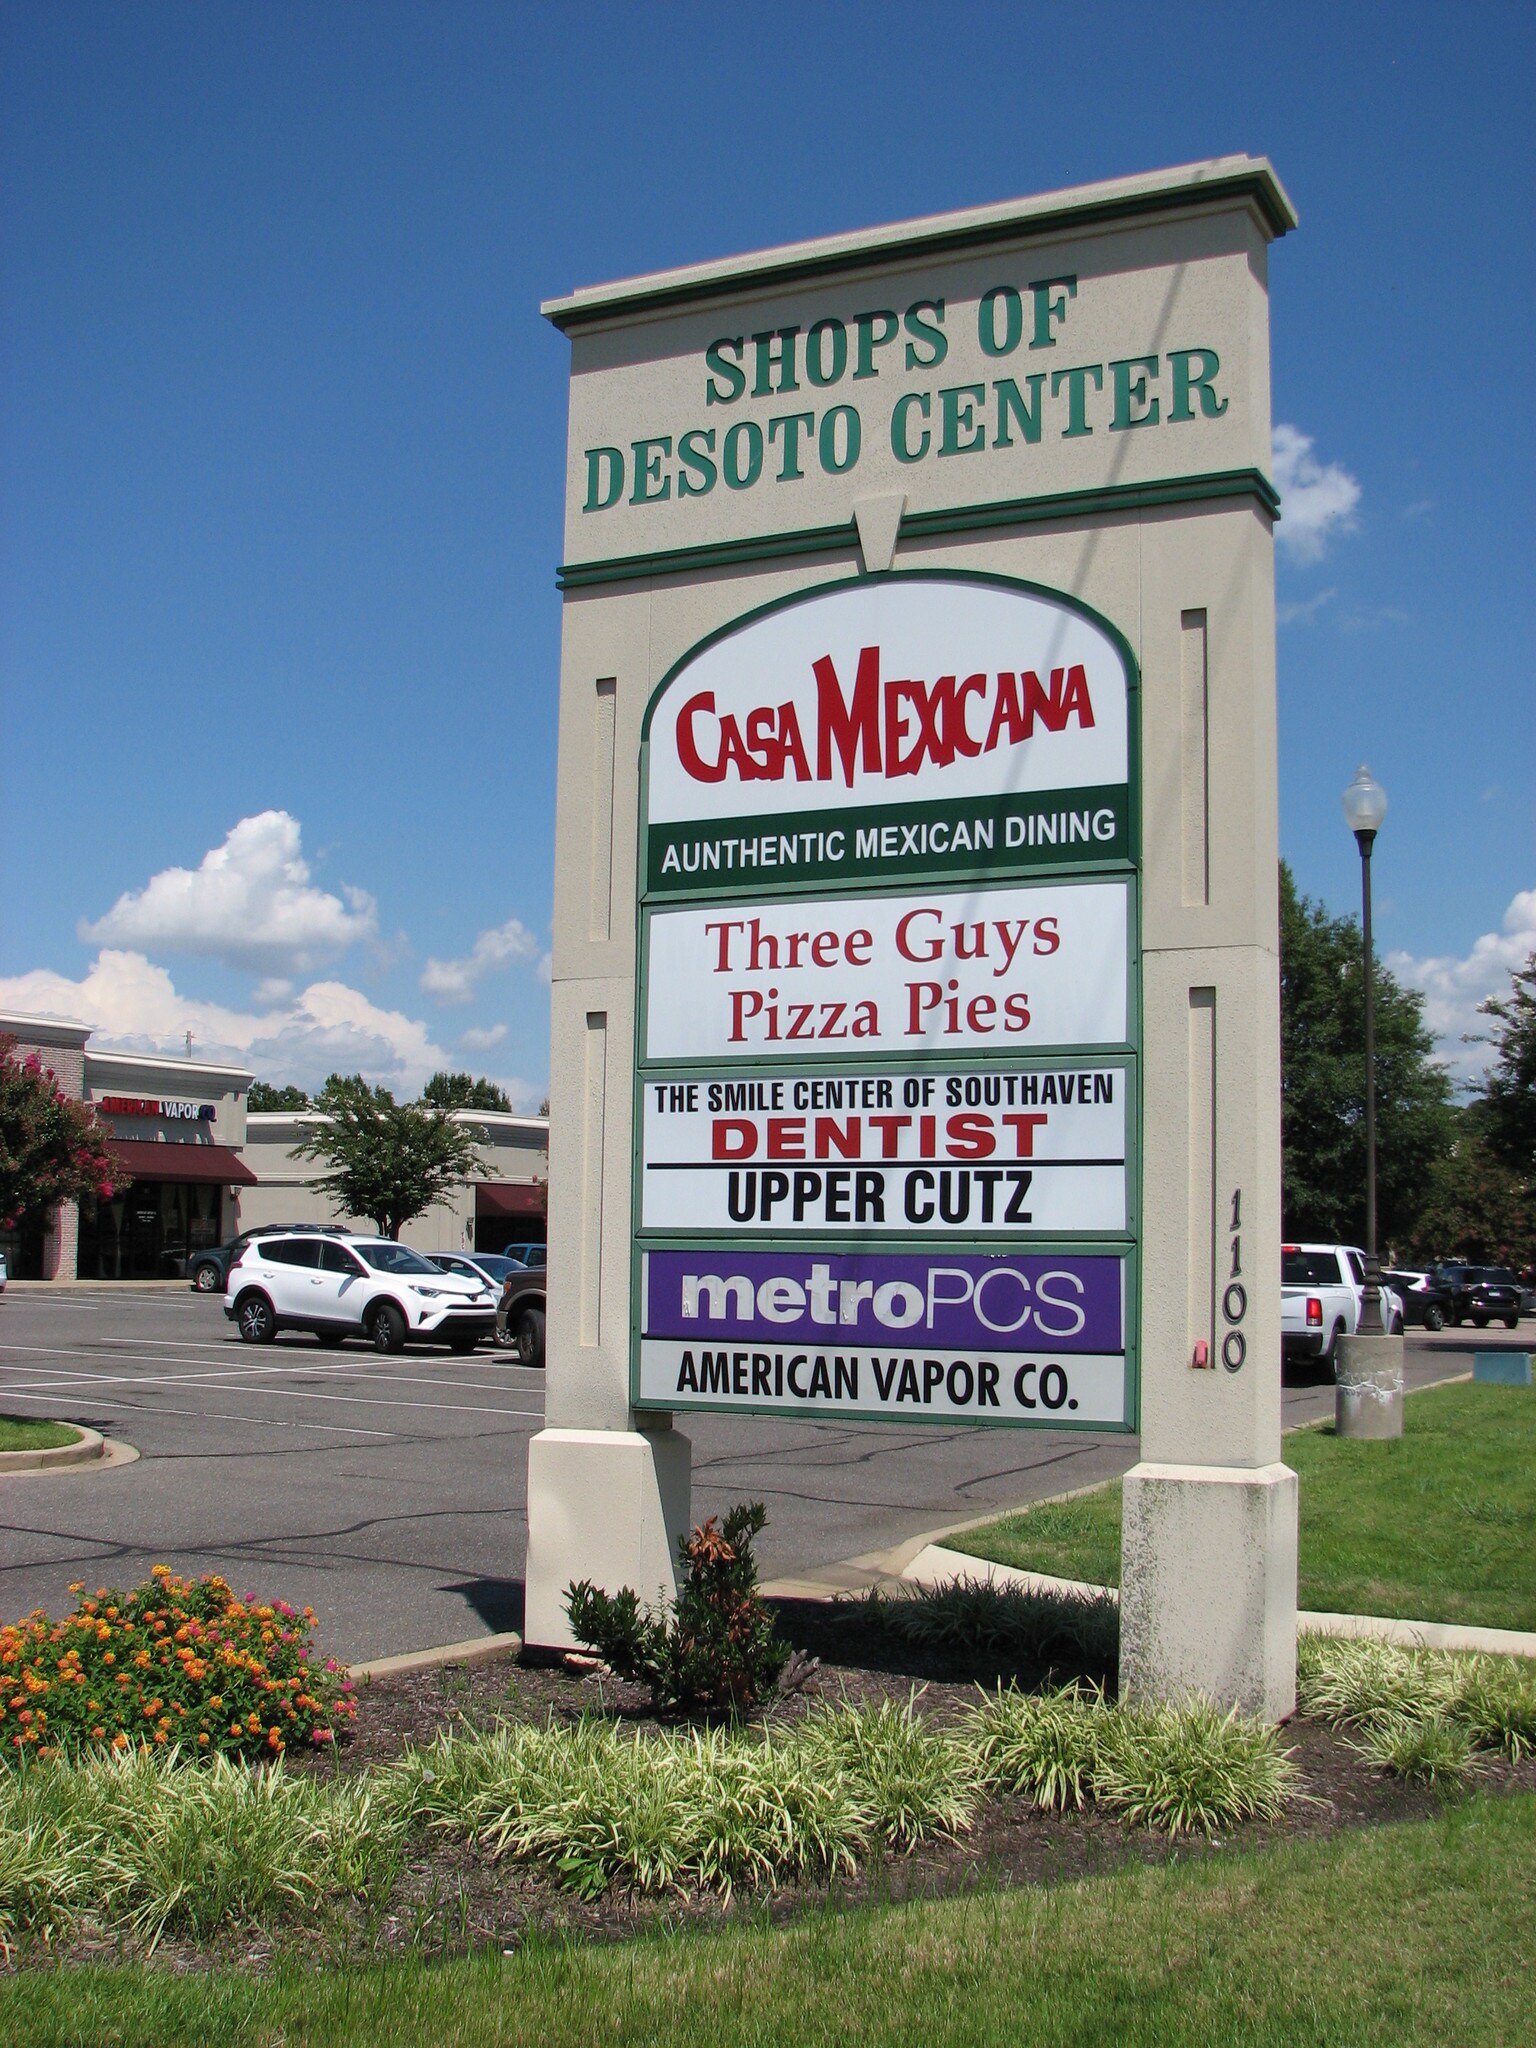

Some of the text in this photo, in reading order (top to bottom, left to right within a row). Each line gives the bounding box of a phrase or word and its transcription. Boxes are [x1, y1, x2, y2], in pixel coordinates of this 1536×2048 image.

[705, 274, 1079, 407] SHOPS OF
[582, 347, 1230, 514] DESOTO CENTER
[676, 645, 1096, 788] CASA MEXICANA
[661, 808, 1117, 874] AUNTHENTIC MEXICAN DINING
[704, 908, 1062, 978] Three Guys
[726, 978, 1032, 1044] Pizza Pies
[164, 1101, 199, 1121] VAPOR
[655, 1073, 1114, 1114] THE SMILE CENTER OF SOUTHAVEN
[711, 1113, 1049, 1161] DENTIST
[727, 1170, 1033, 1224] UPPER CUTZ
[681, 1263, 1087, 1338] metroPCS
[1221, 1188, 1248, 1374] 1100
[676, 1350, 1079, 1411] AMERICAN VAPOR CO.
